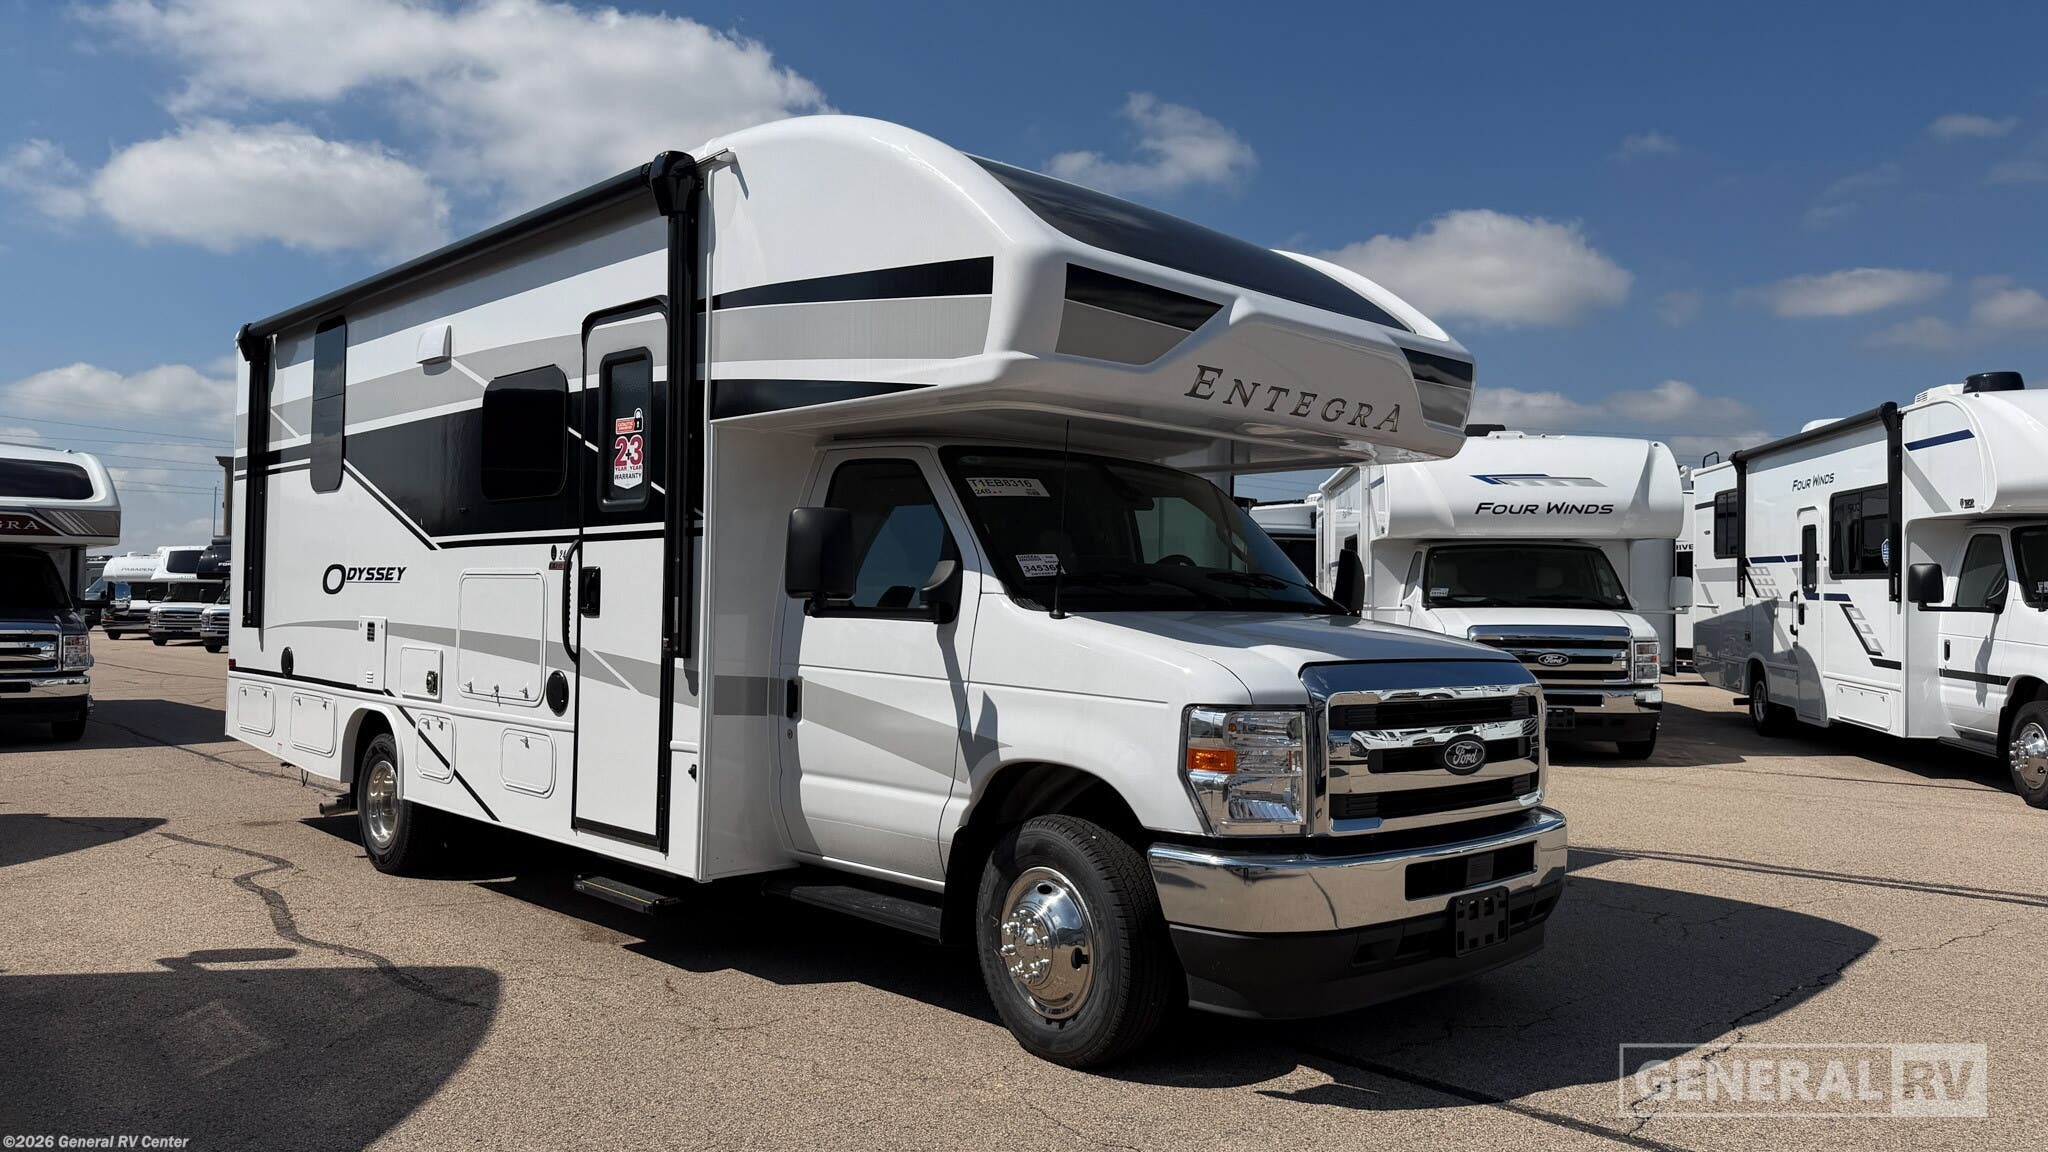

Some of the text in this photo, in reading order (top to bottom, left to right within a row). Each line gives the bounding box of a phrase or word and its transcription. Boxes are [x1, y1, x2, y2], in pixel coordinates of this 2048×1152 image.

[1184, 364, 1401, 433] ENTEGRA
[614, 472, 642, 480] WARRANTY
[1792, 472, 1835, 492] FOUR WINDS
[1474, 501, 1614, 515] FOUR WINDS
[322, 563, 408, 595] ODYSSEY
[1452, 744, 1478, 765] Ford
